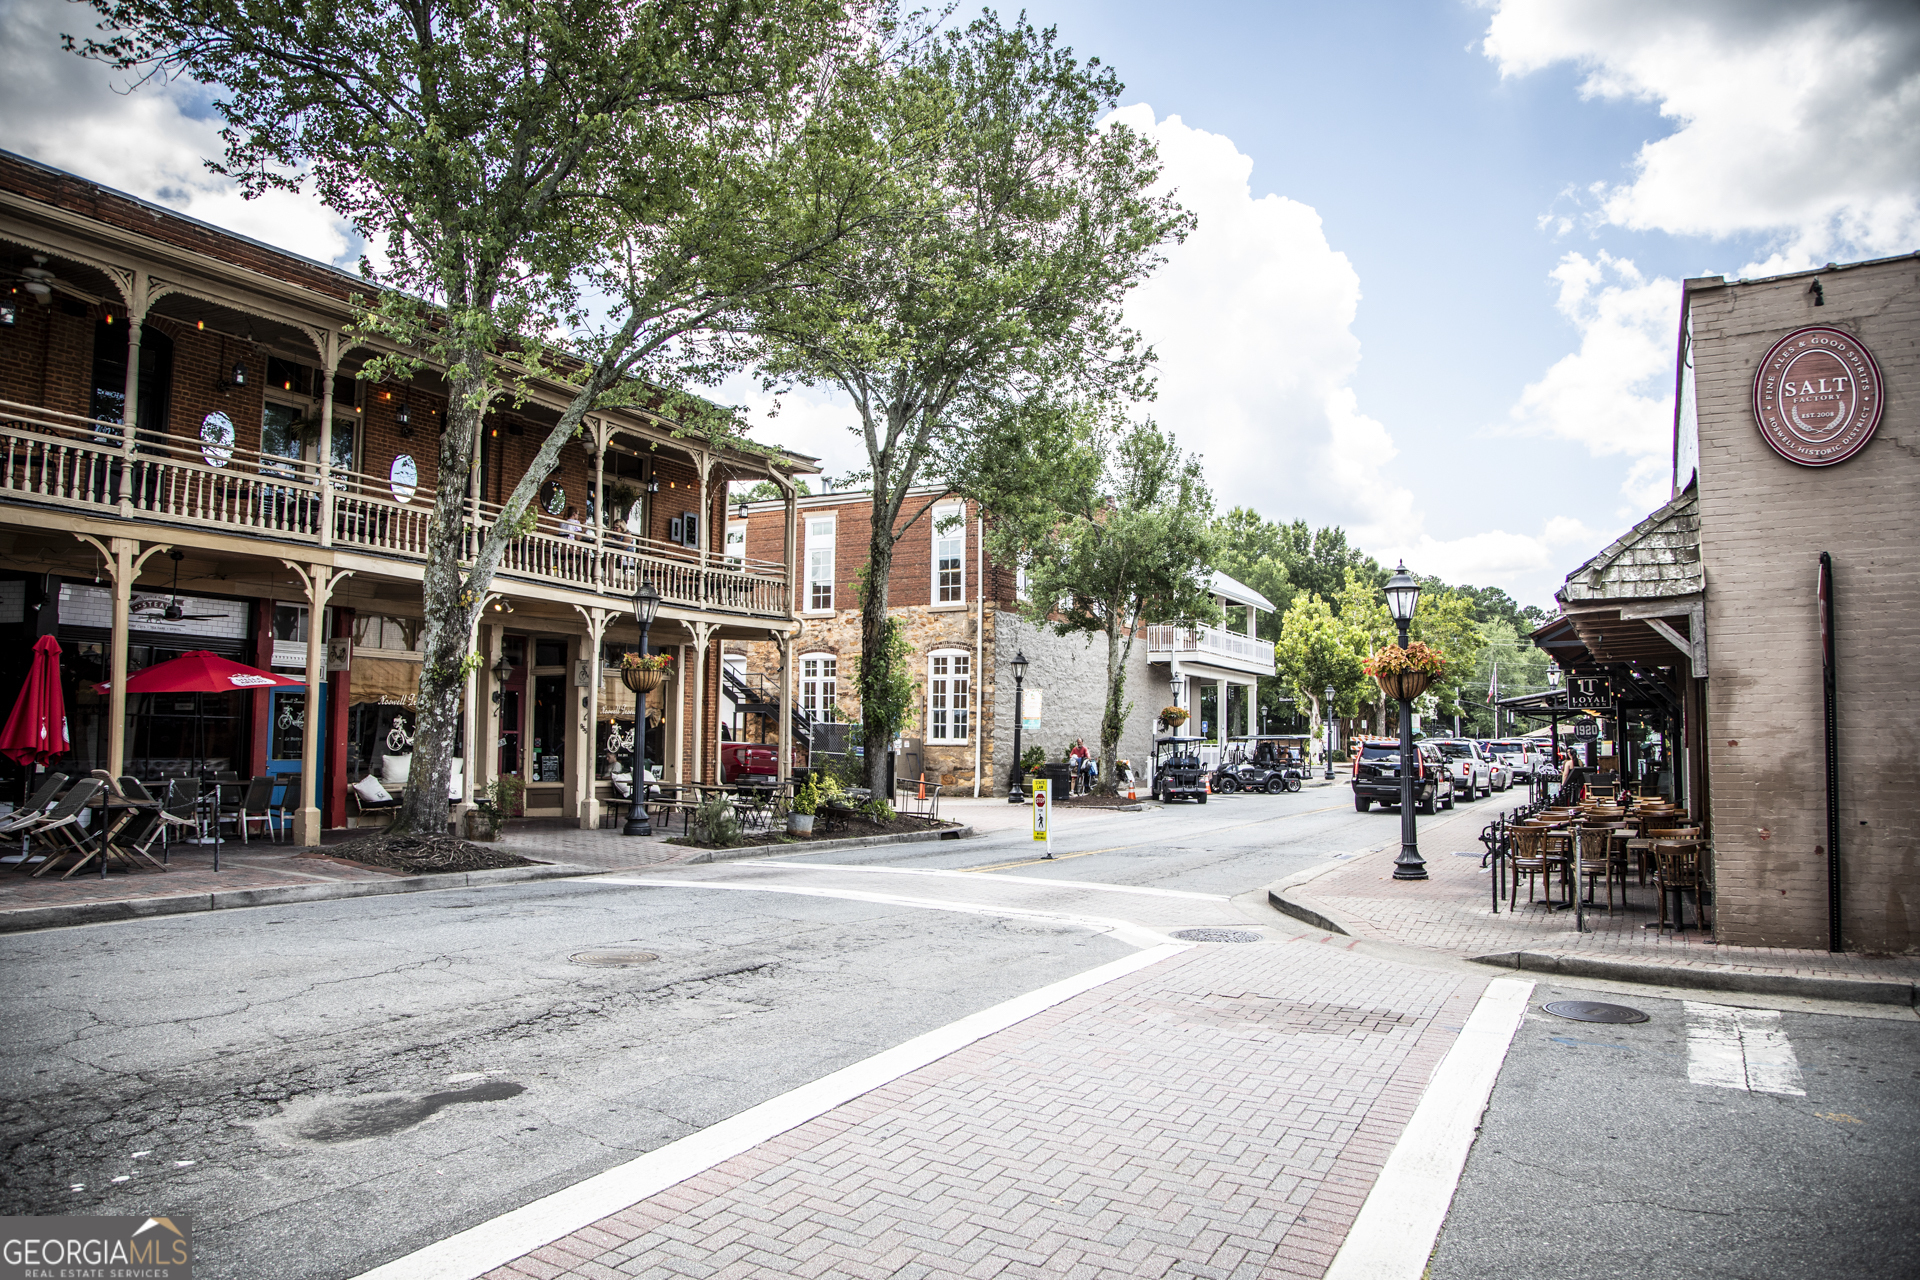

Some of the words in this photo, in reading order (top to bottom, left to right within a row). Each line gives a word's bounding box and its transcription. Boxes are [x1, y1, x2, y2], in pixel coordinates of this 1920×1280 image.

[1765, 375, 1776, 400] FINE
[1774, 346, 1795, 370] ALES
[1798, 340, 1807, 348] &
[1811, 337, 1846, 351] GOOD
[1846, 351, 1870, 391] SPIRITS
[1784, 377, 1848, 397] SALT
[1793, 393, 1842, 404] FACTORY
[1768, 416, 1795, 449] ROSWELL
[1797, 444, 1842, 456] HISTORIC
[1841, 406, 1870, 445] DISTRICT
[142, 601, 169, 610] STEA
[1579, 679, 1599, 696] LT
[377, 694, 407, 706] Roswell
[1572, 696, 1607, 704] LOYAL
[1576, 724, 1598, 736] 1920
[1544, 774, 1562, 782] 1920
